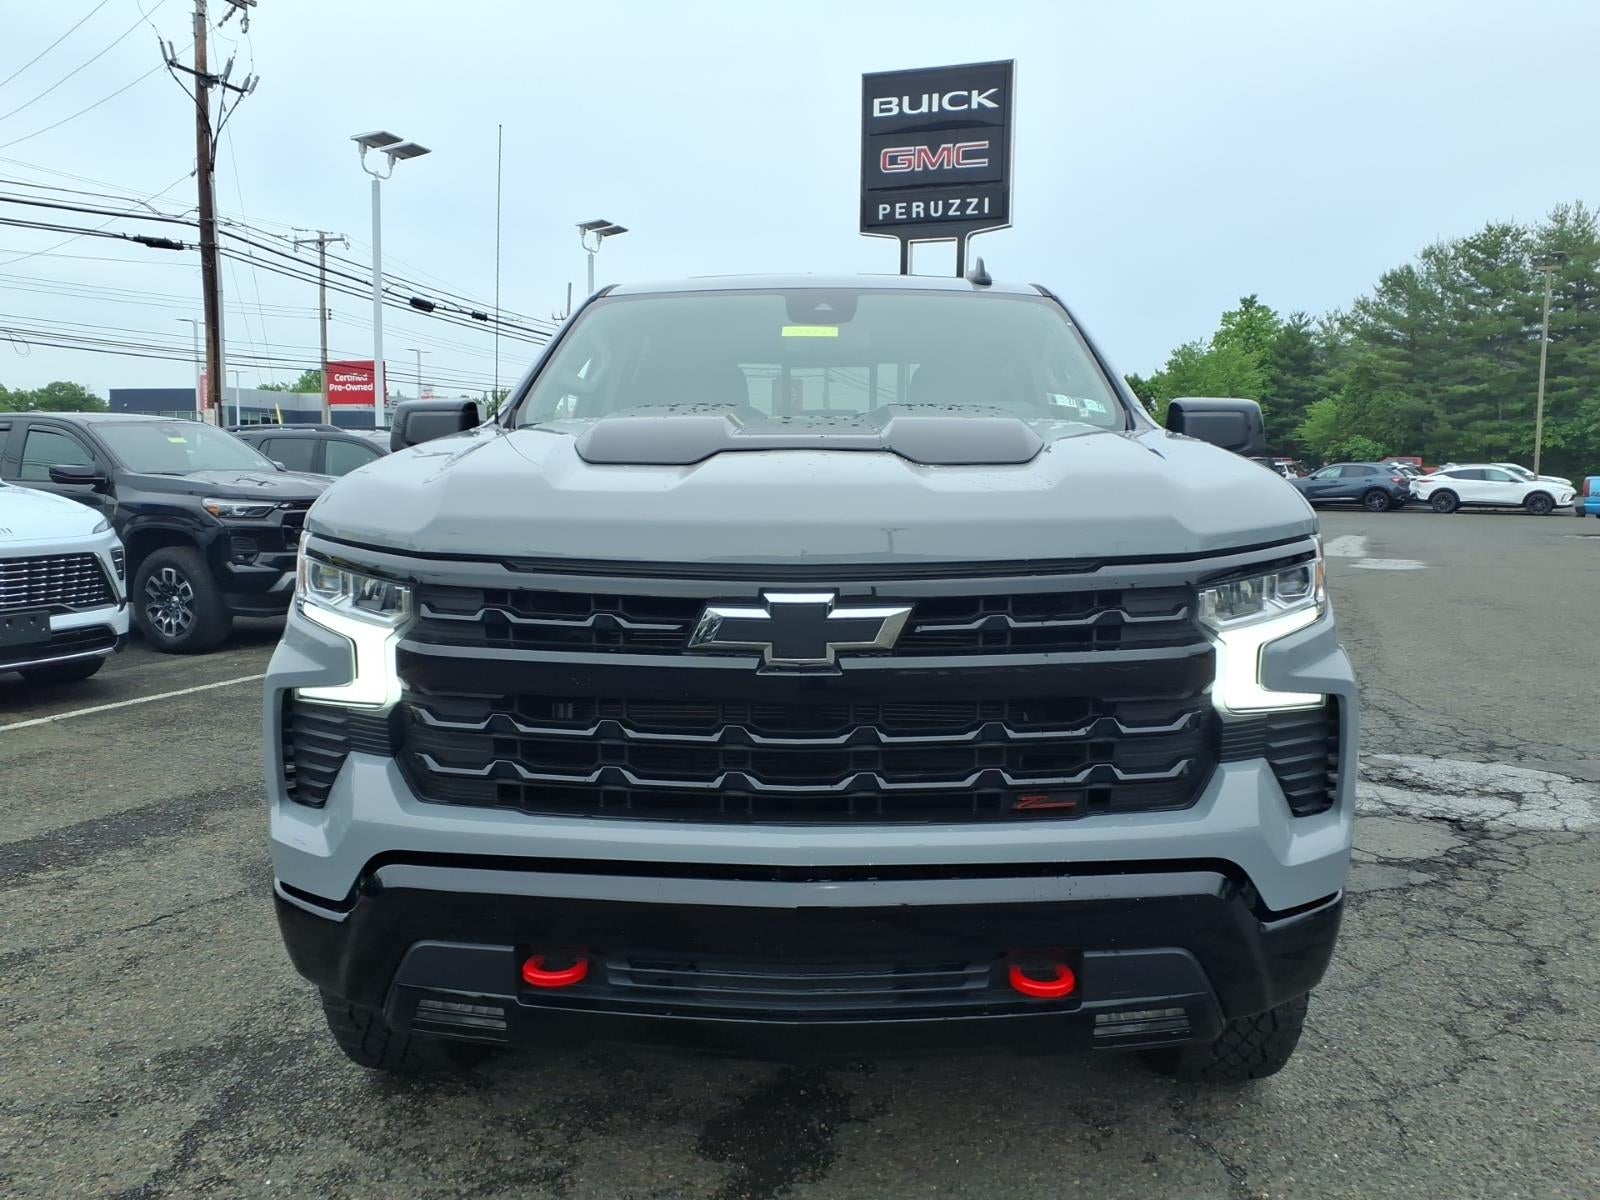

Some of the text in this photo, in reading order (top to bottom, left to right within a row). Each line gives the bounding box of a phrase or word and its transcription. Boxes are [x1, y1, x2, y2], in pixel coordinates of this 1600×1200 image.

[873, 88, 999, 117] BUICK
[880, 141, 989, 173] GMC
[878, 197, 989, 220] PERUZZI
[329, 383, 373, 391] Pre-Owned
[334, 373, 368, 382] Certified
